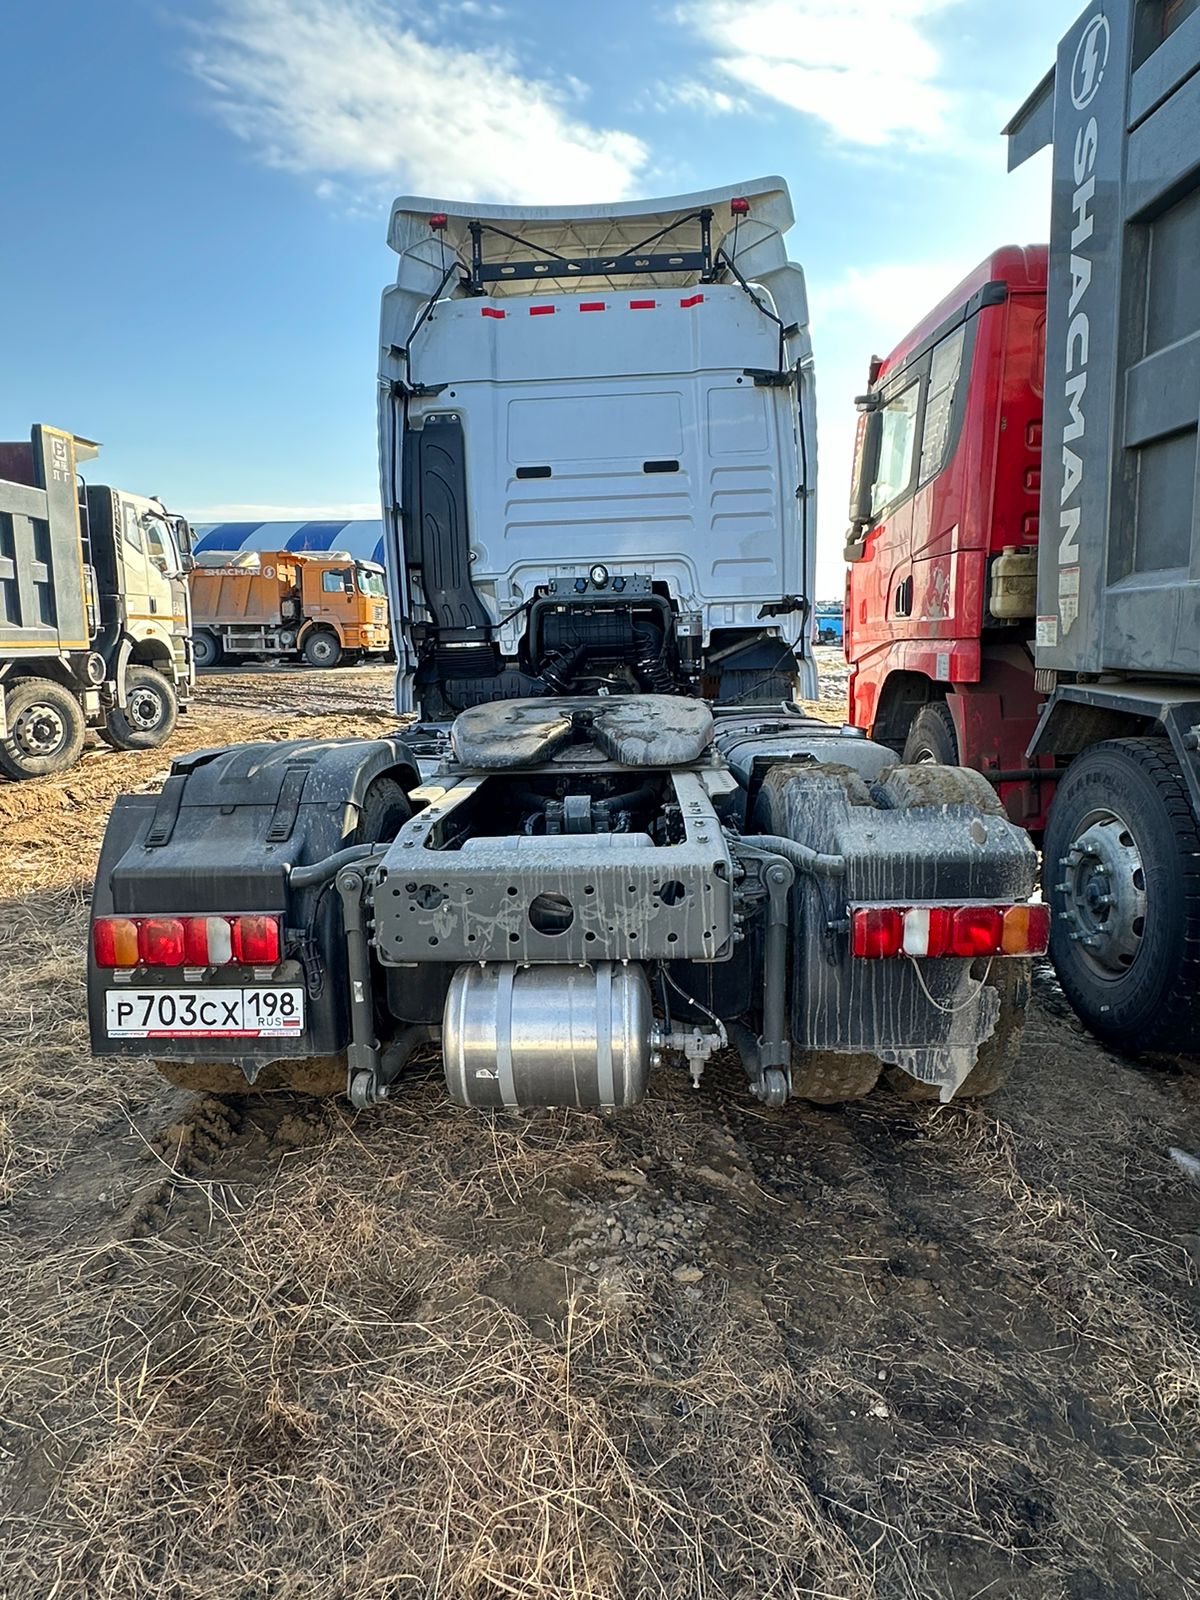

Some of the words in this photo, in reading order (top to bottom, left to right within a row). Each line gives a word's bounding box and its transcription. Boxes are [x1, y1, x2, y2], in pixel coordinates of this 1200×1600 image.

[1058, 117, 1098, 565] SHACMAN
[204, 568, 260, 576] SHACMAN
[248, 992, 295, 1017] 198
[258, 1016, 282, 1026] RUS
